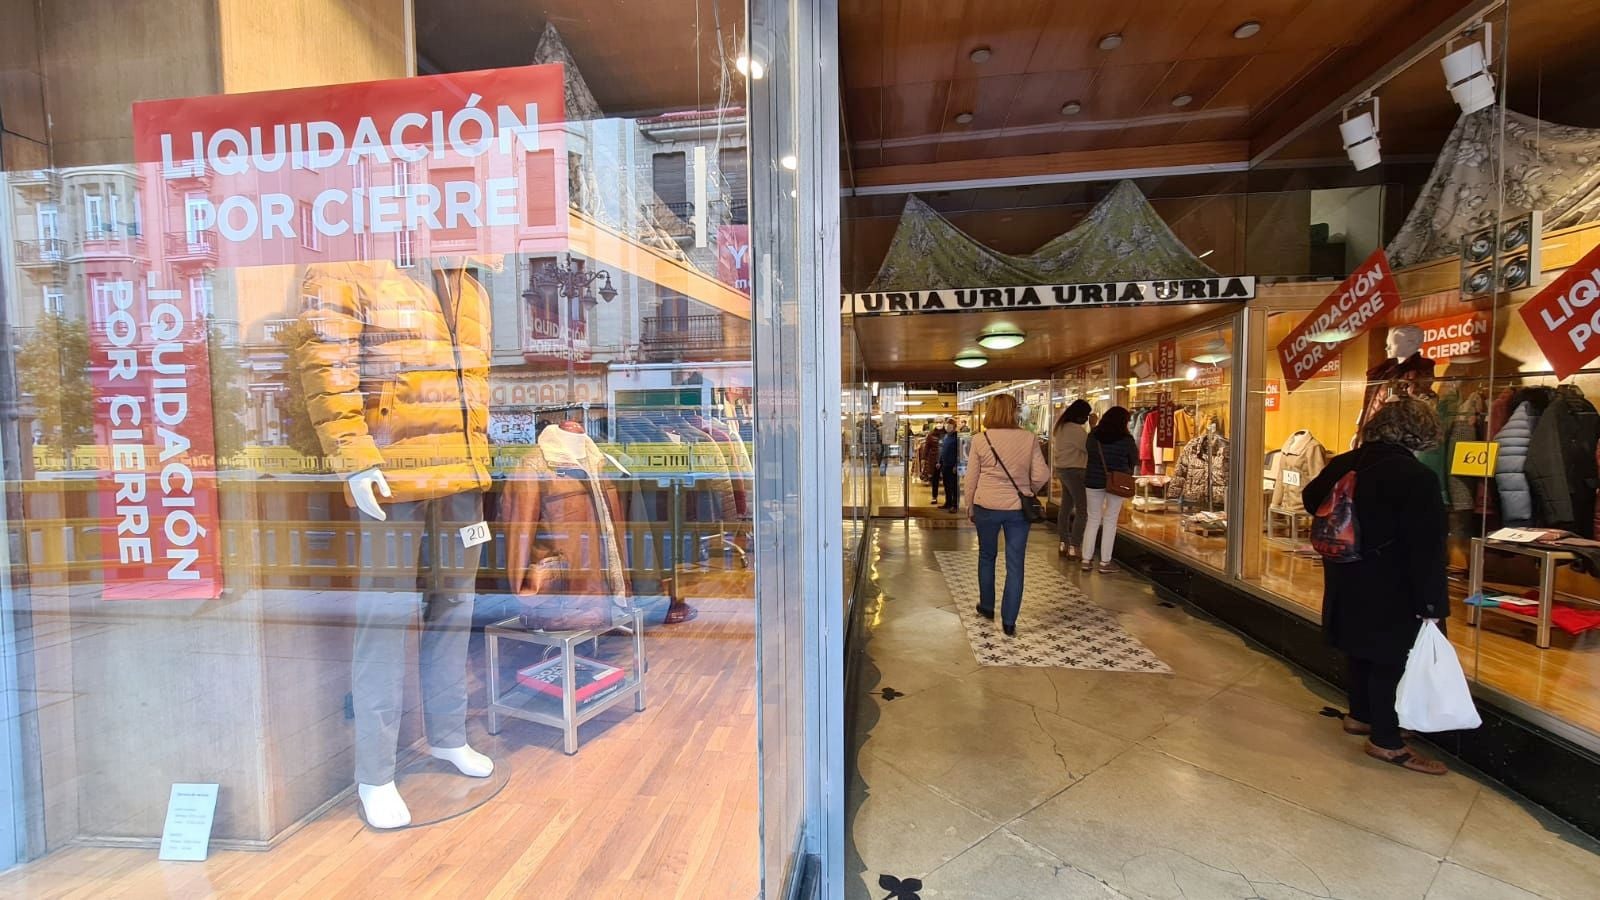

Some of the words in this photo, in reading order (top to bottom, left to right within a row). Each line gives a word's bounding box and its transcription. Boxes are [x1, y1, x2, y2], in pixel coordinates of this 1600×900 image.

[161, 93, 540, 180] LIQUIDACIÓN
[186, 193, 297, 242] POR
[313, 177, 520, 237] CIERRE
[862, 291, 945, 311] URIA
[955, 288, 1042, 307] URIA
[1052, 282, 1145, 304] URIA
[1153, 278, 1248, 299] URIA
[1284, 263, 1384, 363] LIQUIDACIÓN
[1540, 268, 1600, 331] LIQ
[104, 281, 138, 381] POR
[1294, 345, 1324, 379] POR
[1325, 291, 1385, 351] CERRE
[1427, 339, 1481, 360] CIERRE
[110, 395, 152, 564] CIERRE
[1463, 451, 1488, 465] 60
[467, 526, 485, 540] 20
